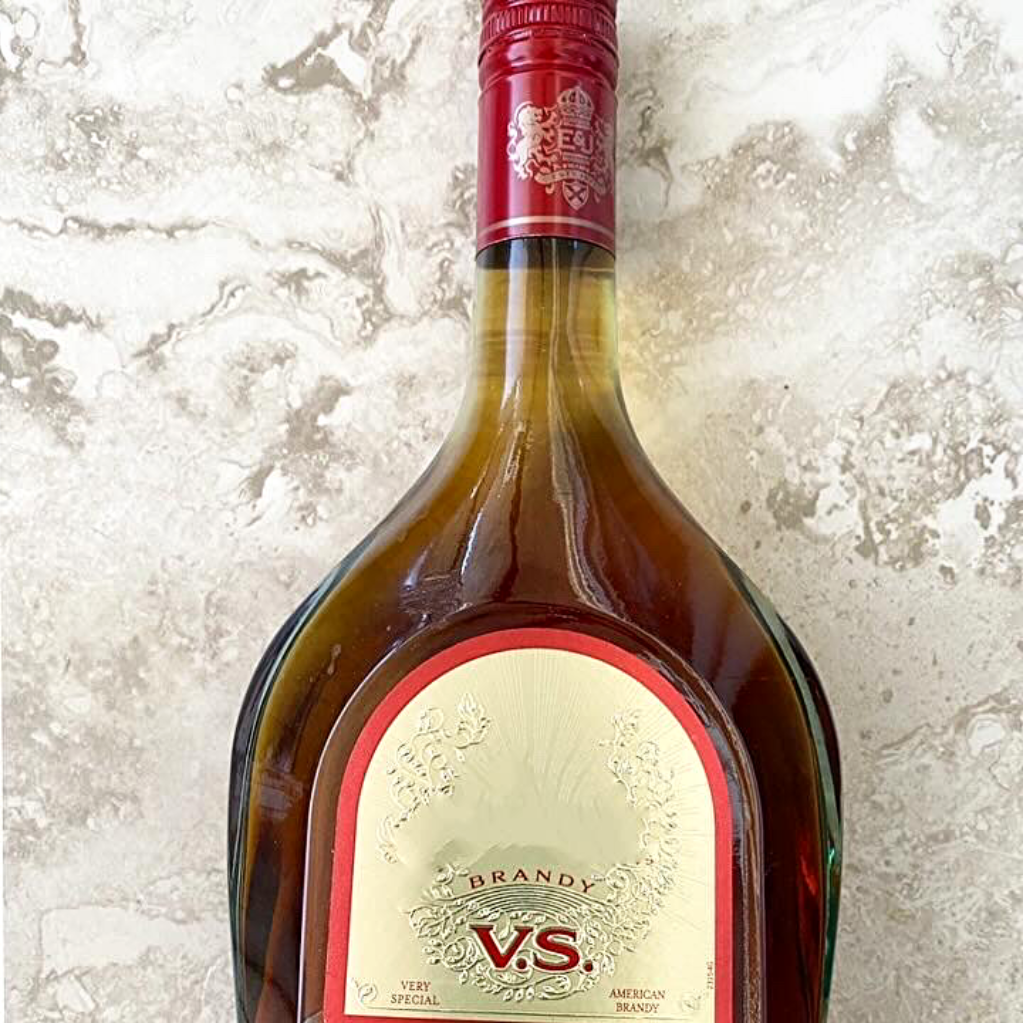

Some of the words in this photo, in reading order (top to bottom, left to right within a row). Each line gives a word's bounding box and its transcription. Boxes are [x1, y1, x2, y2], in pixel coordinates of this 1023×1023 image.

[469, 869, 595, 893] BRANDY
[469, 924, 594, 972] V.S.
[401, 980, 432, 992] VERY
[390, 994, 441, 1006] SPECIAL
[608, 988, 666, 1000] AMERICAN
[615, 1002, 660, 1014] BRANDY
